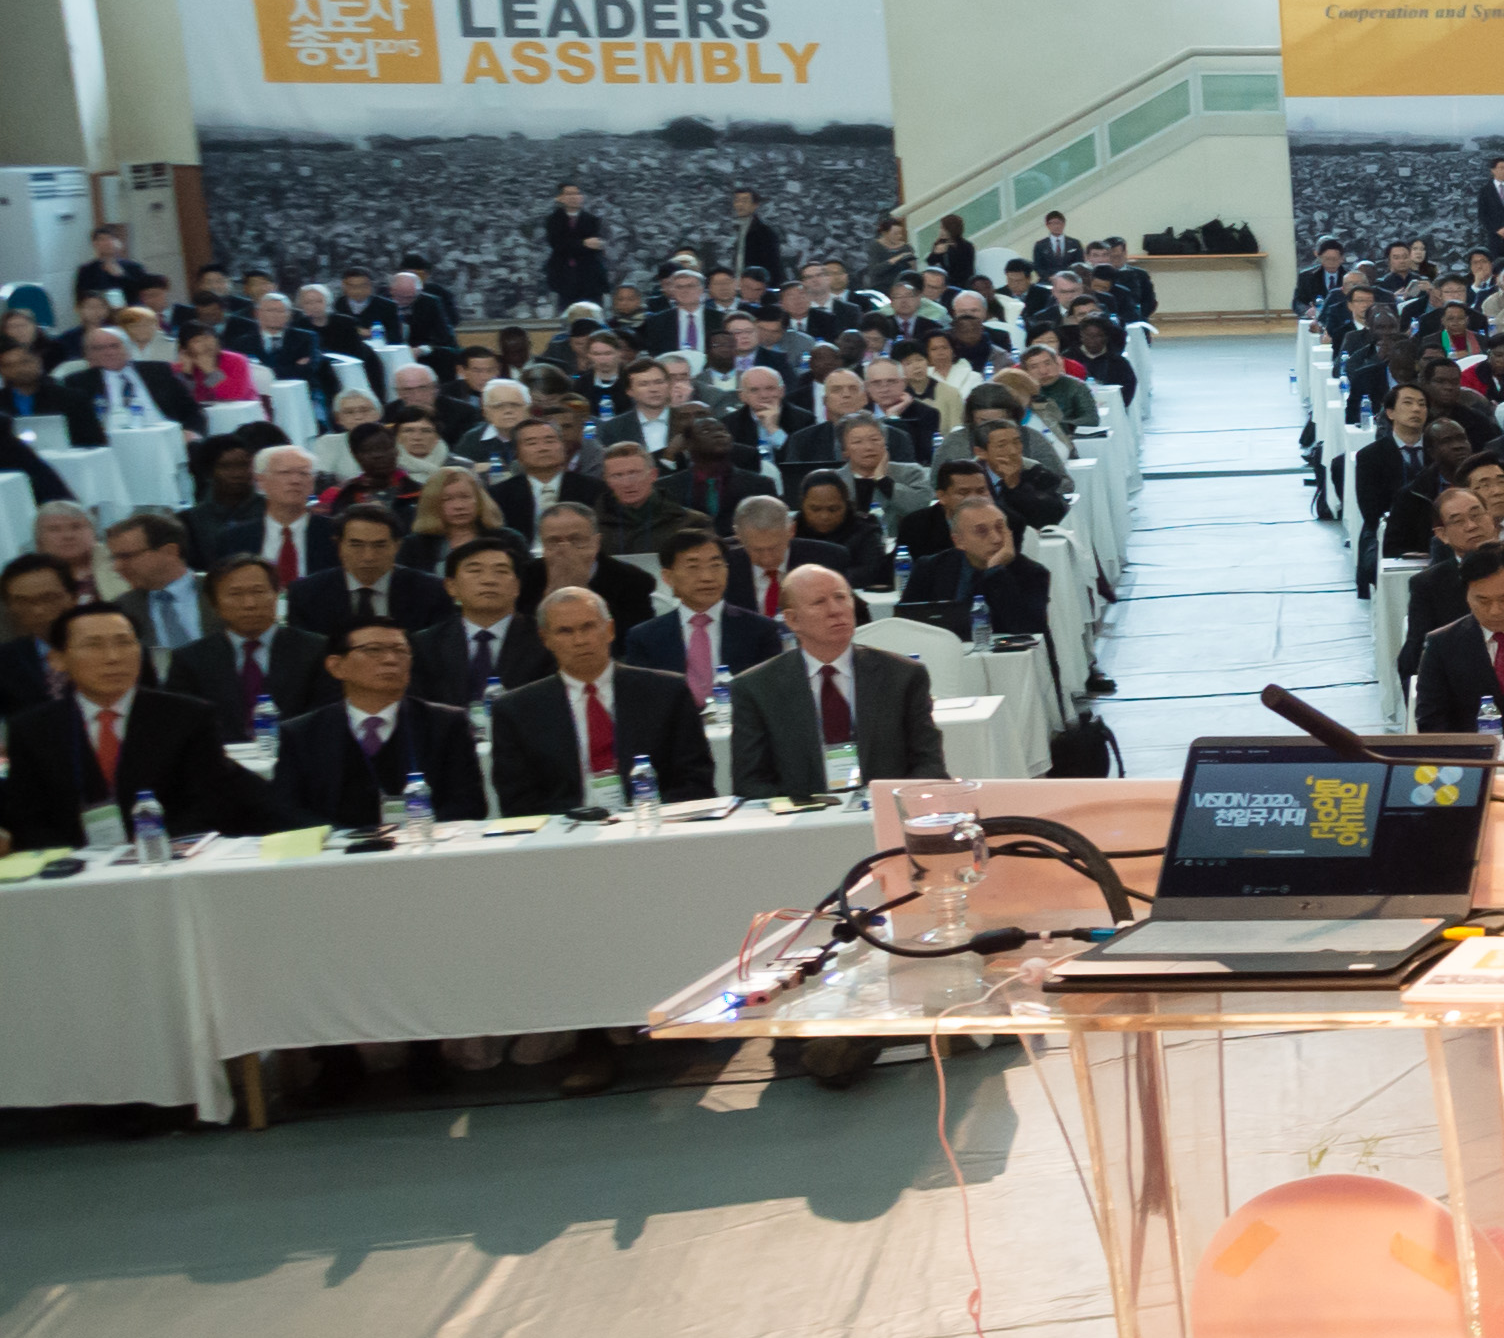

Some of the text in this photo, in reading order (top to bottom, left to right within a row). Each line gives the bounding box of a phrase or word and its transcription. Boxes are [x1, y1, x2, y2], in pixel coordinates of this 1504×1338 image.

[1325, 4, 1429, 22] Cooperation
[1435, 4, 1467, 19] and
[286, 22, 380, 79] 총회
[462, 41, 820, 84] ASSEMBLY
[1193, 792, 1250, 808] VISION
